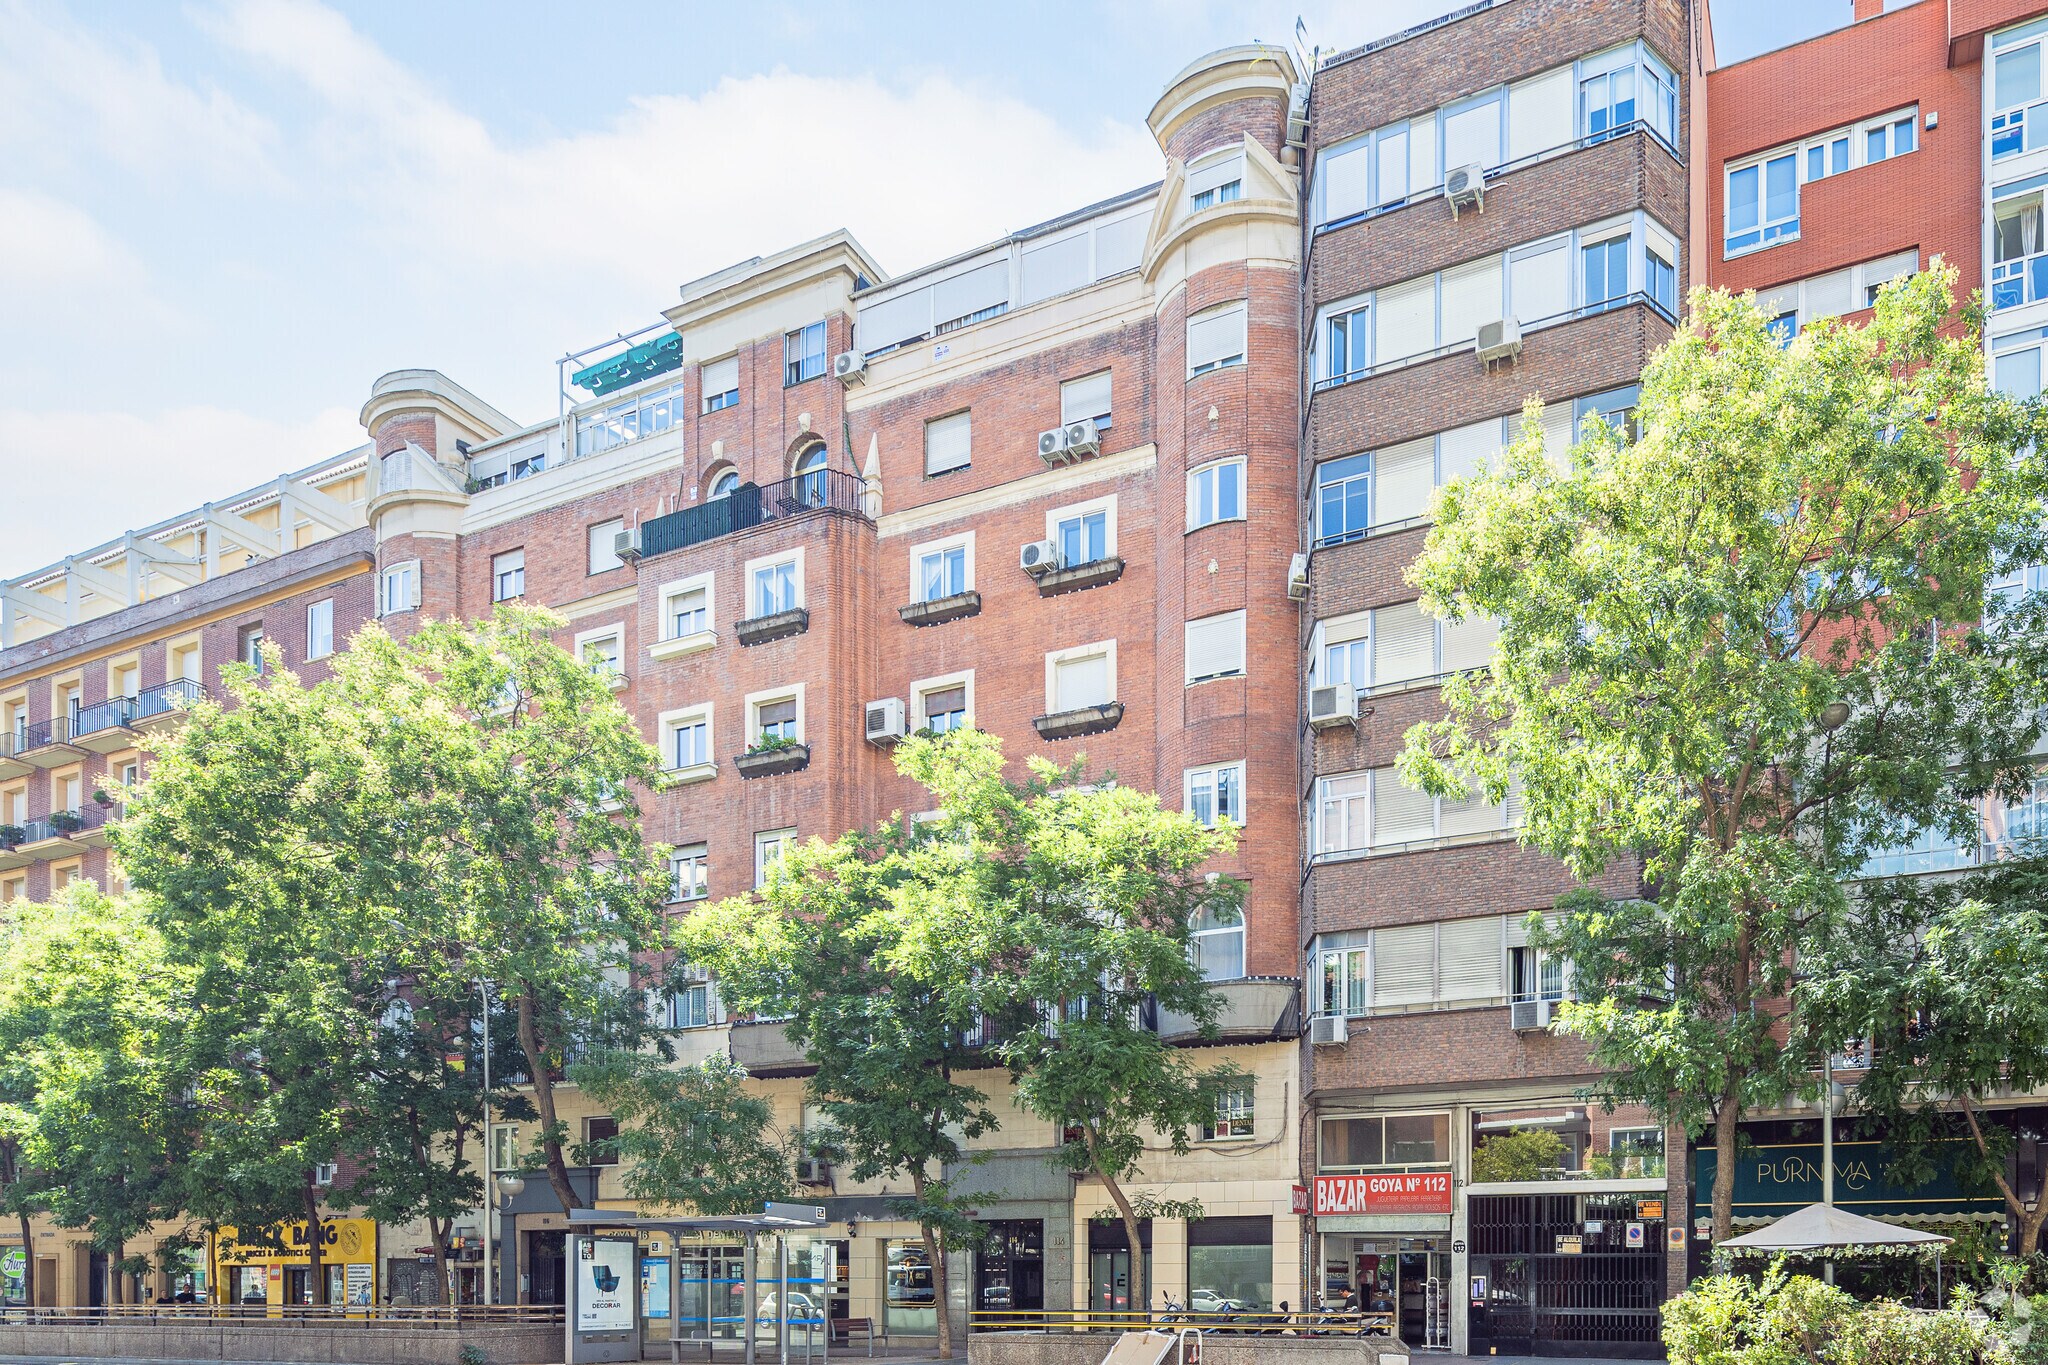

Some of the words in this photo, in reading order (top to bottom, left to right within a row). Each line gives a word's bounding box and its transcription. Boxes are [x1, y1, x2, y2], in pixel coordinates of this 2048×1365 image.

[1232, 1119, 1254, 1127] DENTAL
[1758, 1156, 1871, 1190] PURNMA
[1454, 1179, 1464, 1187] 112
[1293, 1190, 1307, 1210] BAZAR
[1318, 1179, 1367, 1211] BAZAR
[1370, 1178, 1403, 1193] GOYA
[1406, 1177, 1421, 1192] Nº
[1424, 1177, 1446, 1192] 112
[246, 1249, 267, 1257] BRICKS
[274, 1248, 303, 1257] ROBOTICS
[305, 1248, 327, 1257] CER
